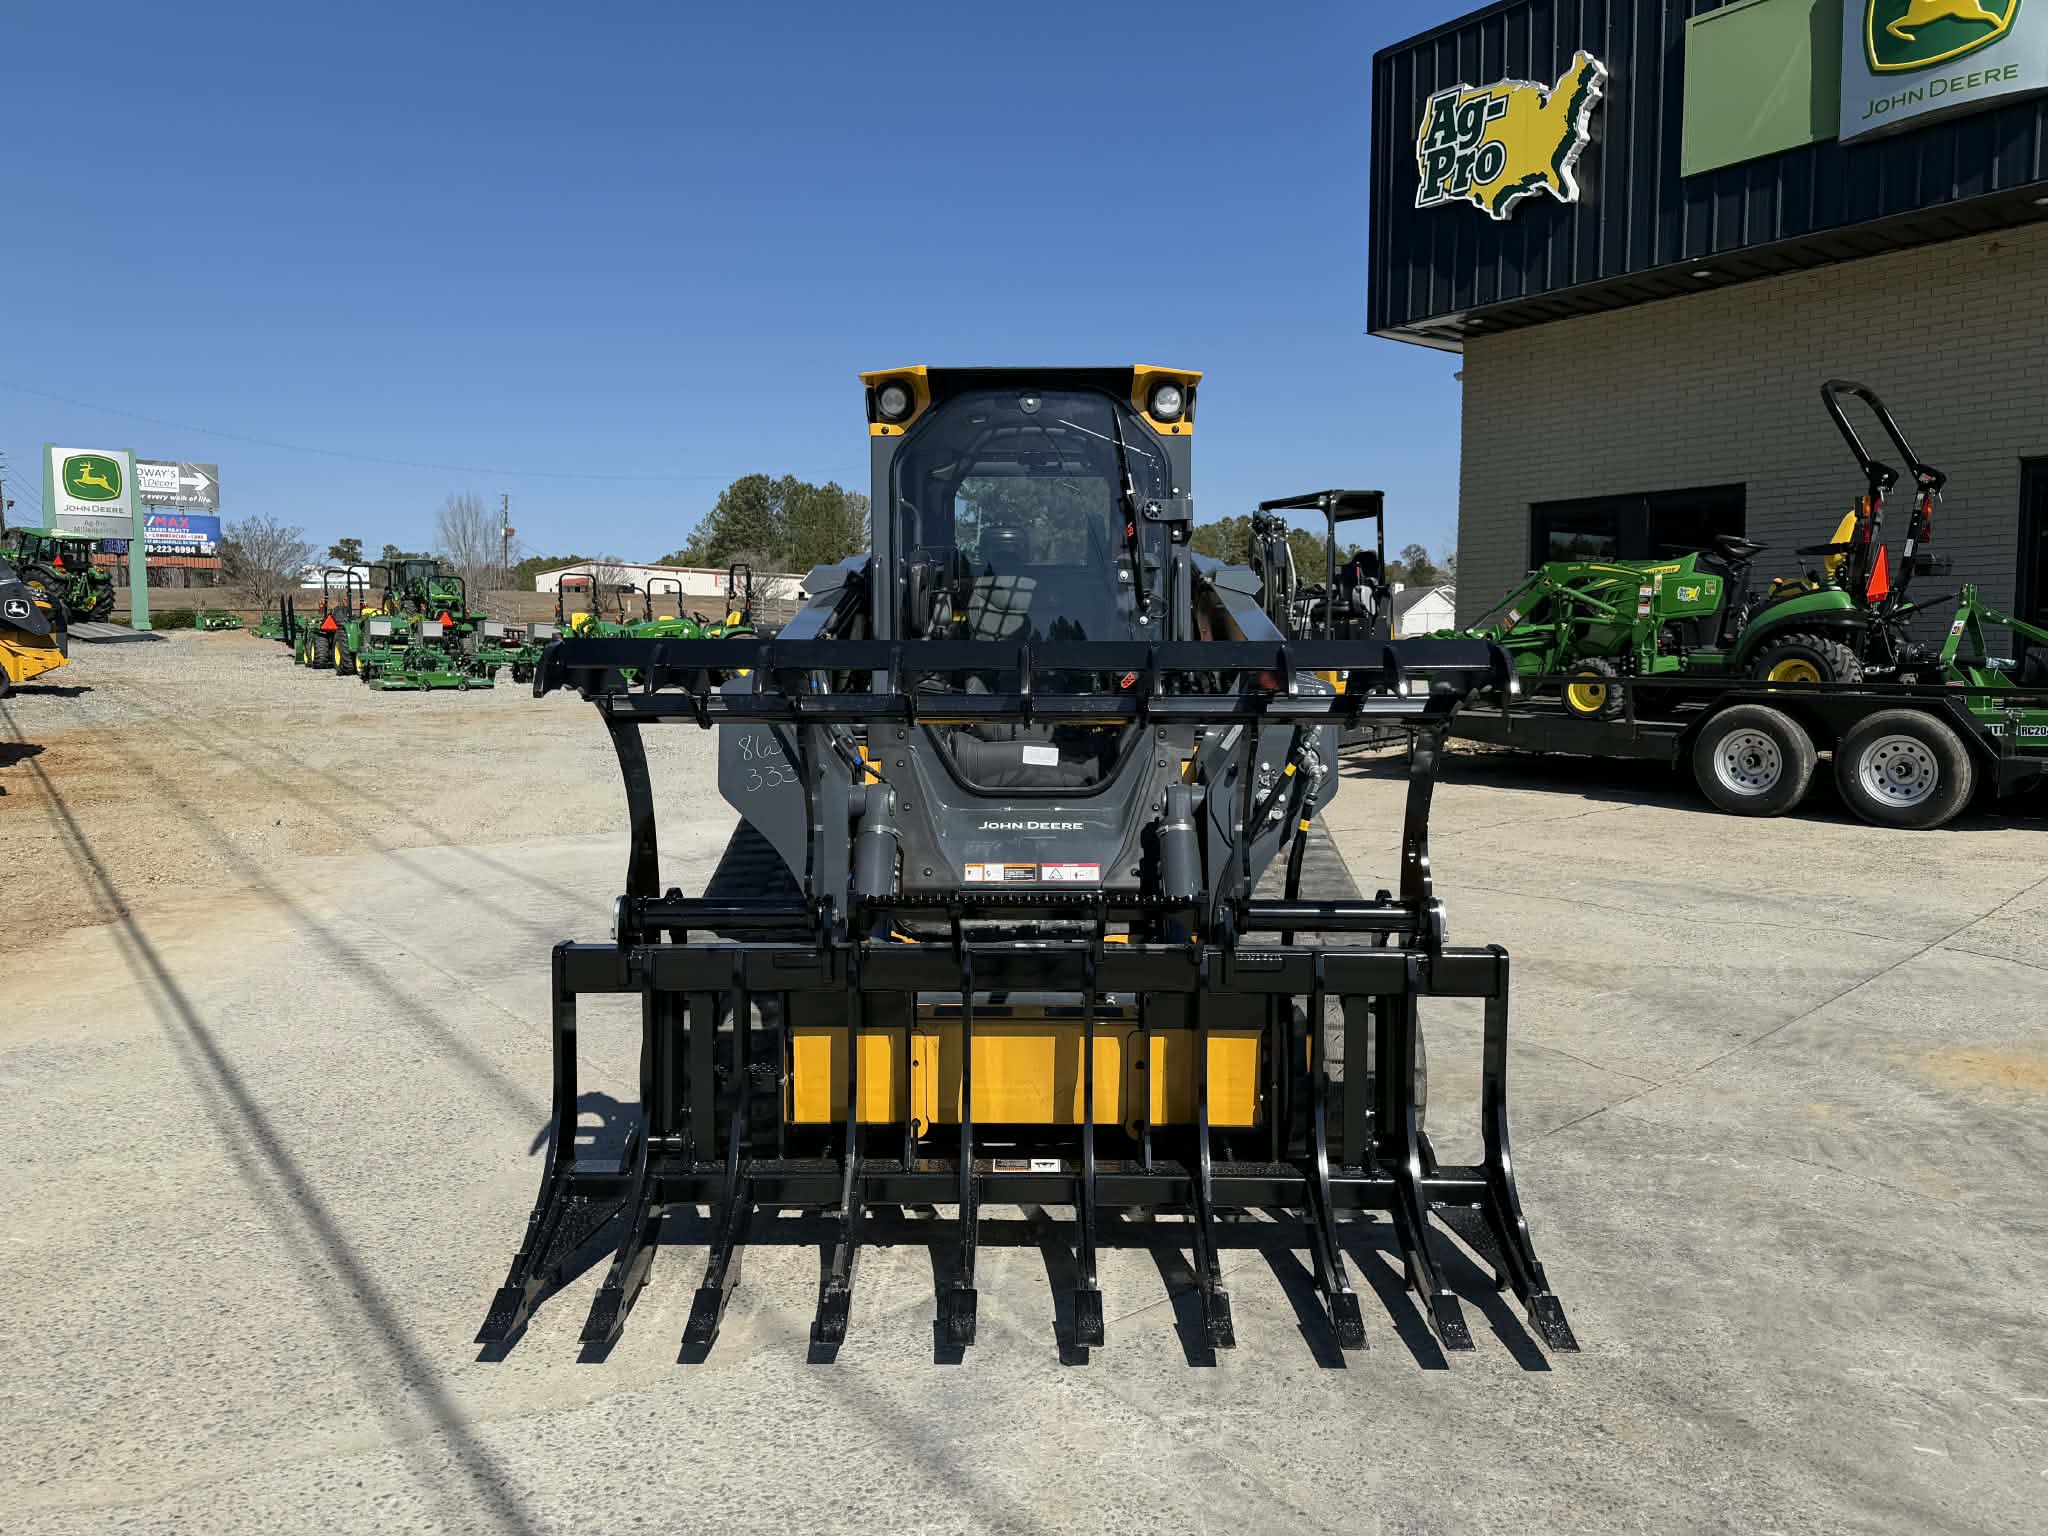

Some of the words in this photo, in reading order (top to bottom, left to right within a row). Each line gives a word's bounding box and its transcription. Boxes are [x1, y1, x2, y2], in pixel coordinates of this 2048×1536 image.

[1862, 87, 1924, 120] JOHN
[1929, 63, 2020, 99] DEERE
[1422, 88, 1509, 153] Ag-
[1417, 141, 1507, 206] Pro
[64, 504, 91, 513] JOHN
[92, 504, 125, 514] DEERE
[2021, 726, 2048, 736] RC20
[977, 820, 1024, 831] JOHN
[1026, 820, 1084, 831] DEERE
